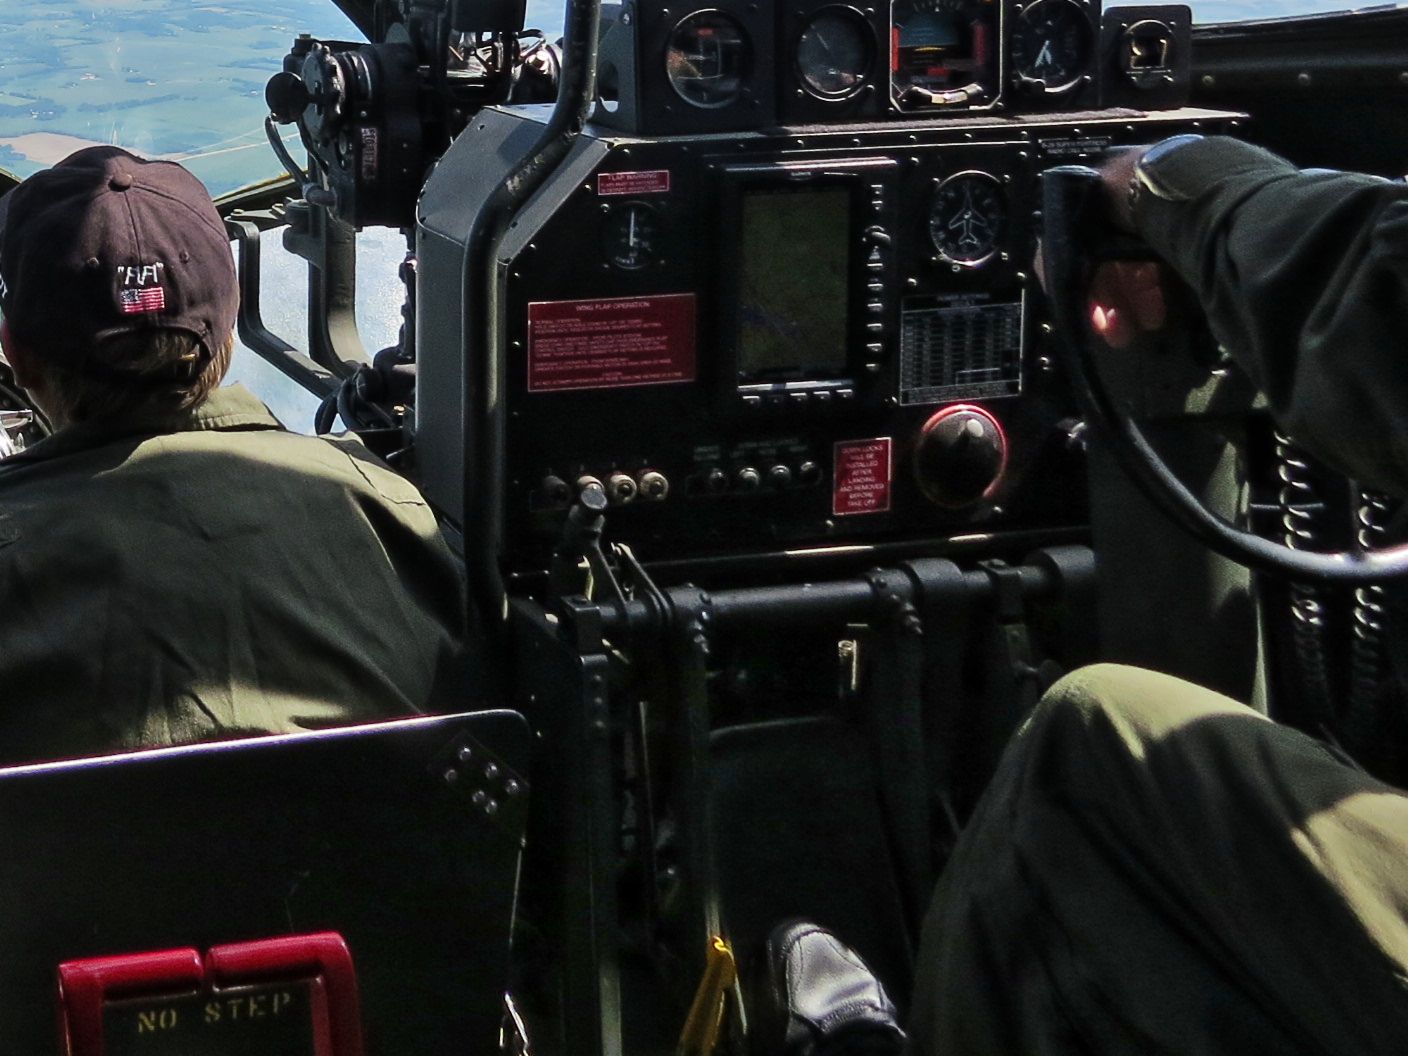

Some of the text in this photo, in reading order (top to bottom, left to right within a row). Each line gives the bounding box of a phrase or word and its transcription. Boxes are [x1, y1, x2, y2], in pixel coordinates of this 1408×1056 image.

[612, 300, 651, 310] OPERATION
[137, 992, 291, 1034] NO STEP
